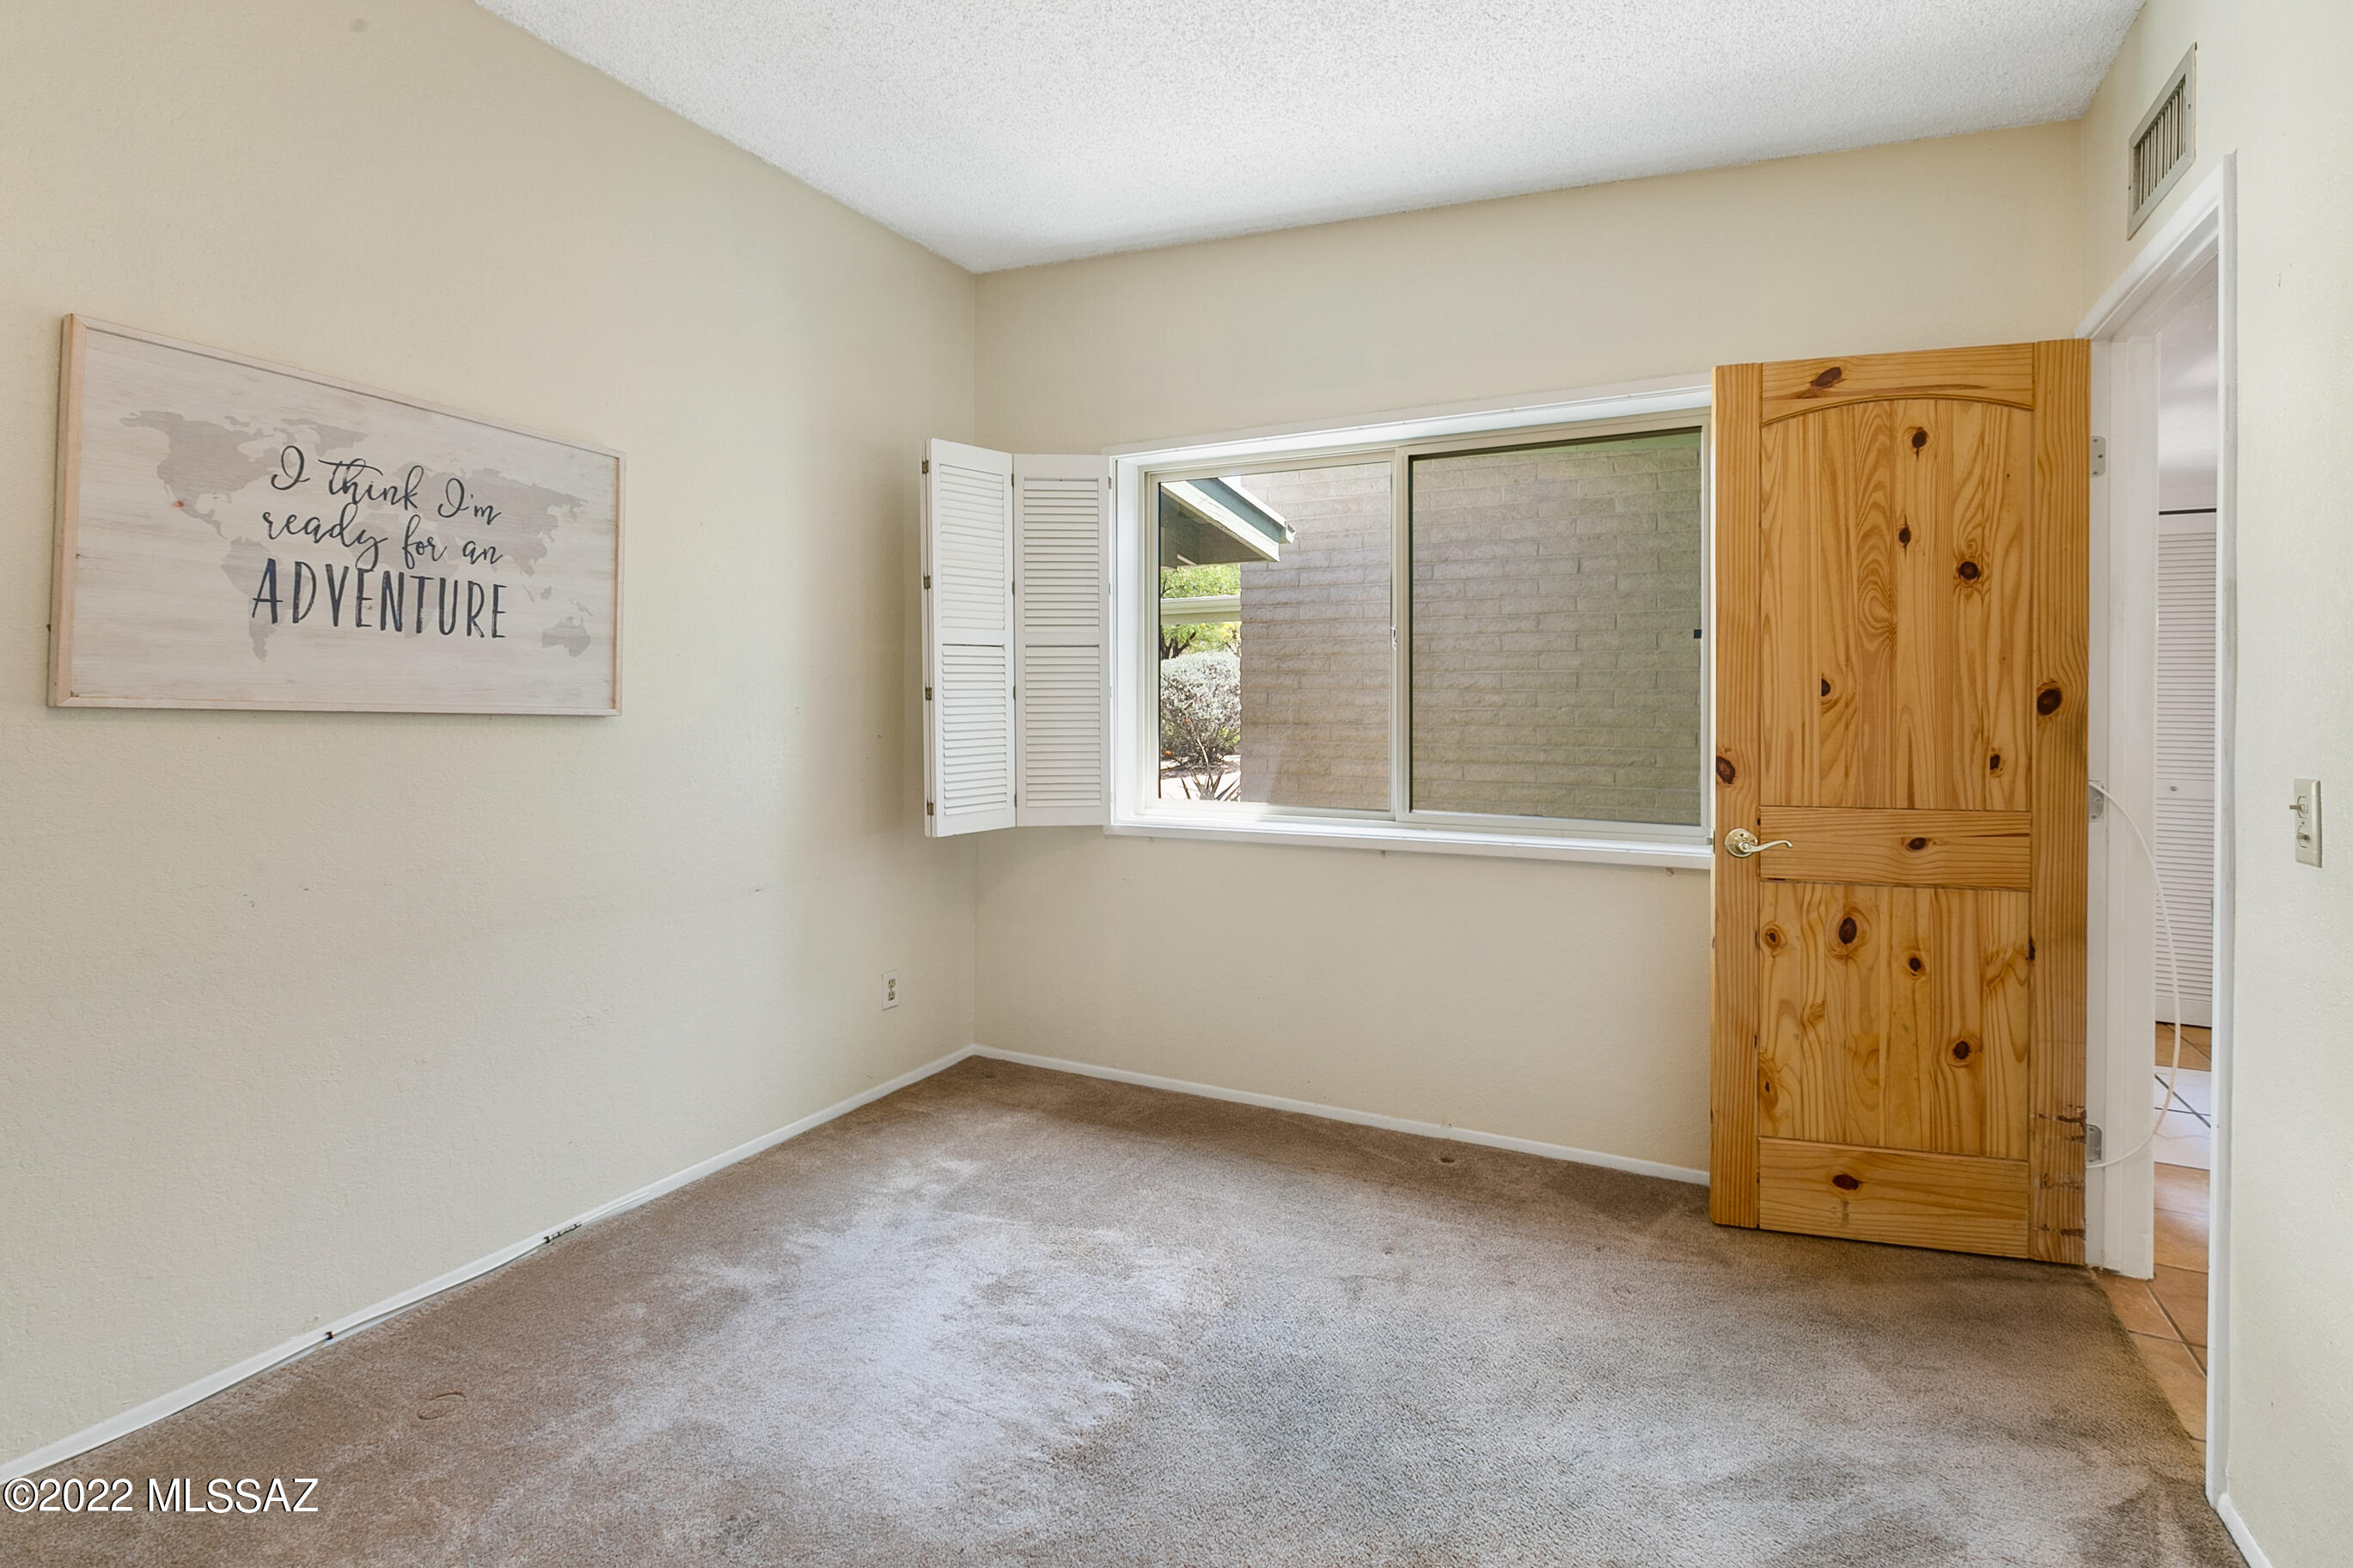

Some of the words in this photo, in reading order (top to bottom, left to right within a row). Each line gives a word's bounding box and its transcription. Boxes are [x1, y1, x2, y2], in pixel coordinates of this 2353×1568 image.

[271, 445, 310, 491] I
[317, 458, 424, 510] think
[437, 478, 502, 526] I'm
[262, 502, 388, 571] ready
[401, 514, 448, 570] for
[461, 540, 504, 565] an
[252, 558, 508, 638] ADVENTURE
